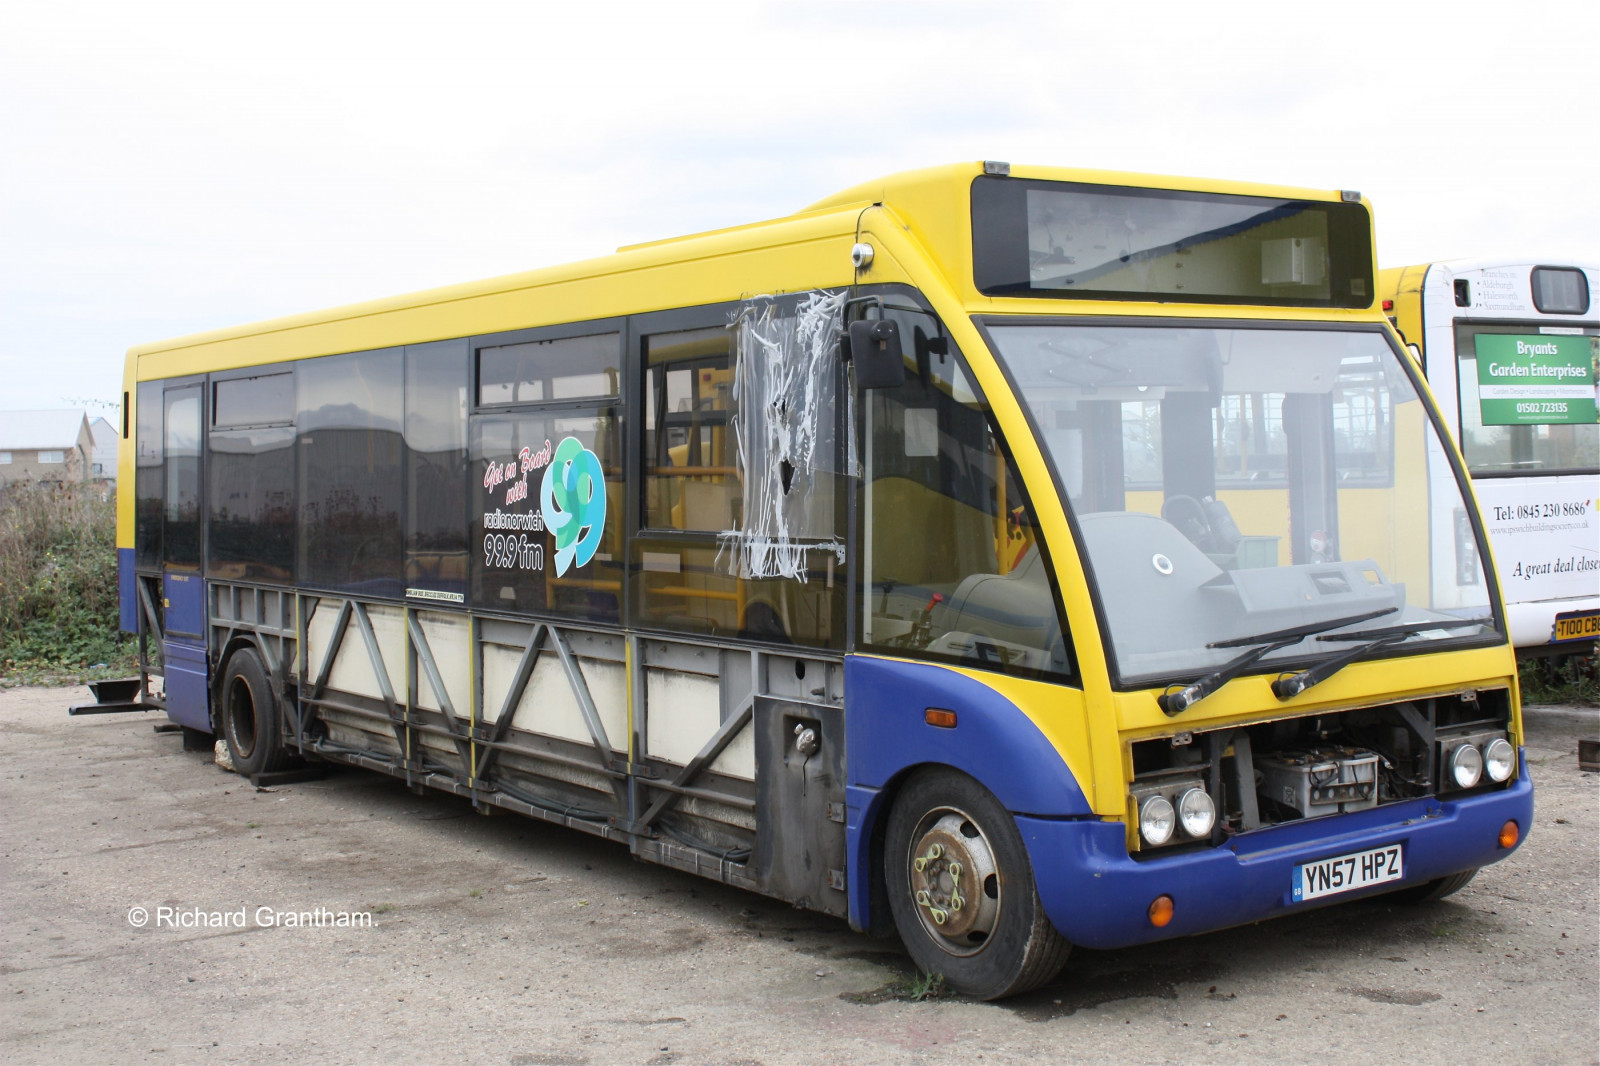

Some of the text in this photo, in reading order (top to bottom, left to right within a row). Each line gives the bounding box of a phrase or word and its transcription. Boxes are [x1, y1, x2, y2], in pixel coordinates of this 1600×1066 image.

[1516, 341, 1558, 358] Bryants
[1489, 362, 1587, 380] Garden Enterprises
[1516, 402, 1568, 413] 01502 723135
[484, 439, 551, 494] Get on Board
[506, 472, 527, 505] with
[484, 508, 543, 531] radionorwich
[1494, 502, 1585, 520] Tel: 0845 230 8686
[1513, 561, 1522, 577] A
[1524, 562, 1551, 580] great
[1554, 557, 1575, 573] deal
[1305, 849, 1398, 893] YN57 HPZ
[1294, 888, 1301, 896] GB
